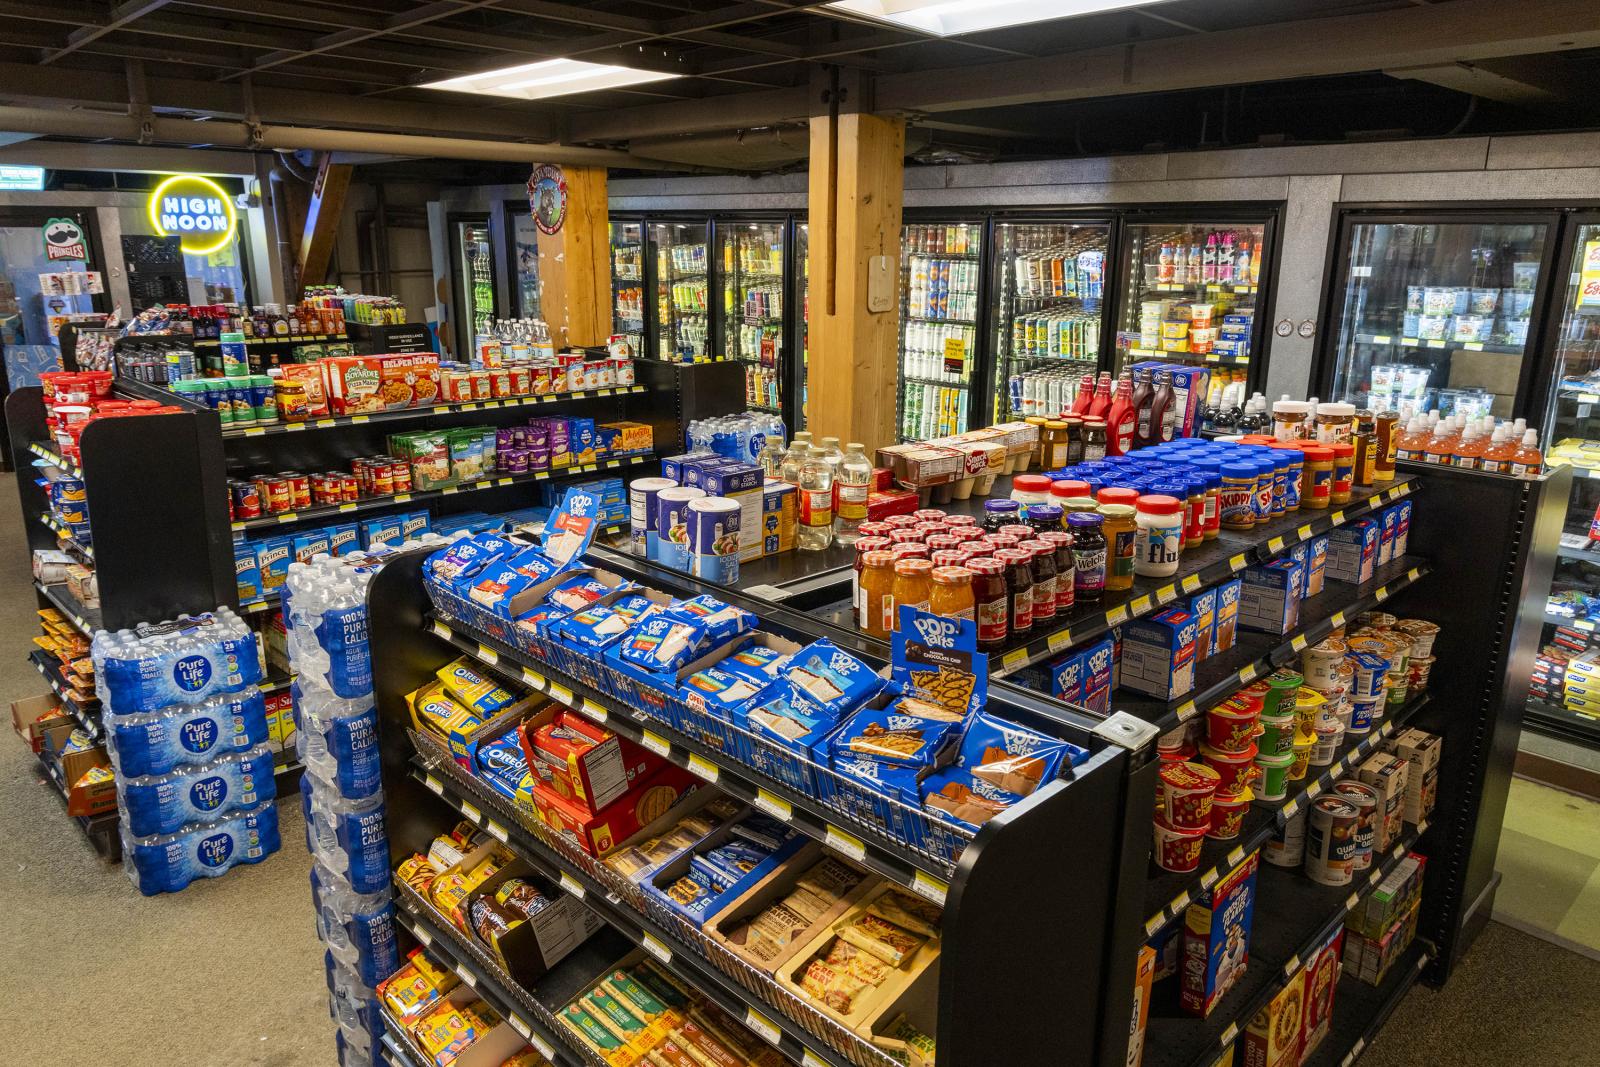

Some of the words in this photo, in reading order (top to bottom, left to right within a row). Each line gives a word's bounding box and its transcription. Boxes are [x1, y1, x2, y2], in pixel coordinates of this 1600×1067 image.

[163, 197, 222, 211] HIGH
[162, 214, 228, 231] NOON
[48, 243, 85, 260] PRINGLES
[383, 359, 413, 369] HELPER
[345, 370, 380, 382] BOYARDEE
[347, 381, 363, 389] Pizza
[966, 454, 988, 466] Snack
[740, 480, 758, 488] STARCH
[1220, 493, 1251, 509] SKIPPY
[403, 518, 426, 532] Prince
[375, 528, 398, 543] Prince
[302, 541, 327, 557] Prince
[1148, 543, 1179, 564] flu
[261, 548, 287, 564] Prince
[1076, 552, 1106, 570] Welch's
[340, 611, 366, 624] 100%
[343, 624, 368, 635] PURA
[344, 633, 369, 645] CALID
[224, 642, 235, 651] 28
[139, 665, 157, 673] PURE
[178, 657, 205, 673] Pure
[182, 668, 204, 681] Life
[454, 668, 481, 685] OREO
[903, 681, 909, 690] 6
[688, 692, 704, 706] OPEN
[232, 704, 242, 712] 28
[425, 703, 452, 719] OREO
[185, 720, 212, 735] Pure
[347, 717, 372, 732] 100%
[147, 730, 165, 738] PURE
[188, 731, 210, 742] Life
[350, 729, 374, 741] PURA
[351, 737, 378, 750] CALIDA
[489, 749, 522, 769] OREO
[958, 756, 965, 766] 2
[241, 762, 252, 771] 28
[195, 778, 222, 793] Pure
[199, 788, 220, 800] Life
[247, 818, 257, 827] 28
[359, 812, 383, 827] 100%
[361, 822, 384, 835] PURA
[202, 834, 228, 849] Pure
[362, 832, 386, 846] CALID
[1353, 832, 1375, 843] QUAK
[205, 845, 226, 857] Life
[1336, 843, 1356, 855] QUAK
[367, 912, 390, 926] 100%
[370, 922, 392, 936] PURA
[664, 1014, 677, 1026] BIG
[643, 1032, 656, 1044] BIG
[621, 1050, 633, 1063] BIG
[1247, 1039, 1257, 1067] ROAST
